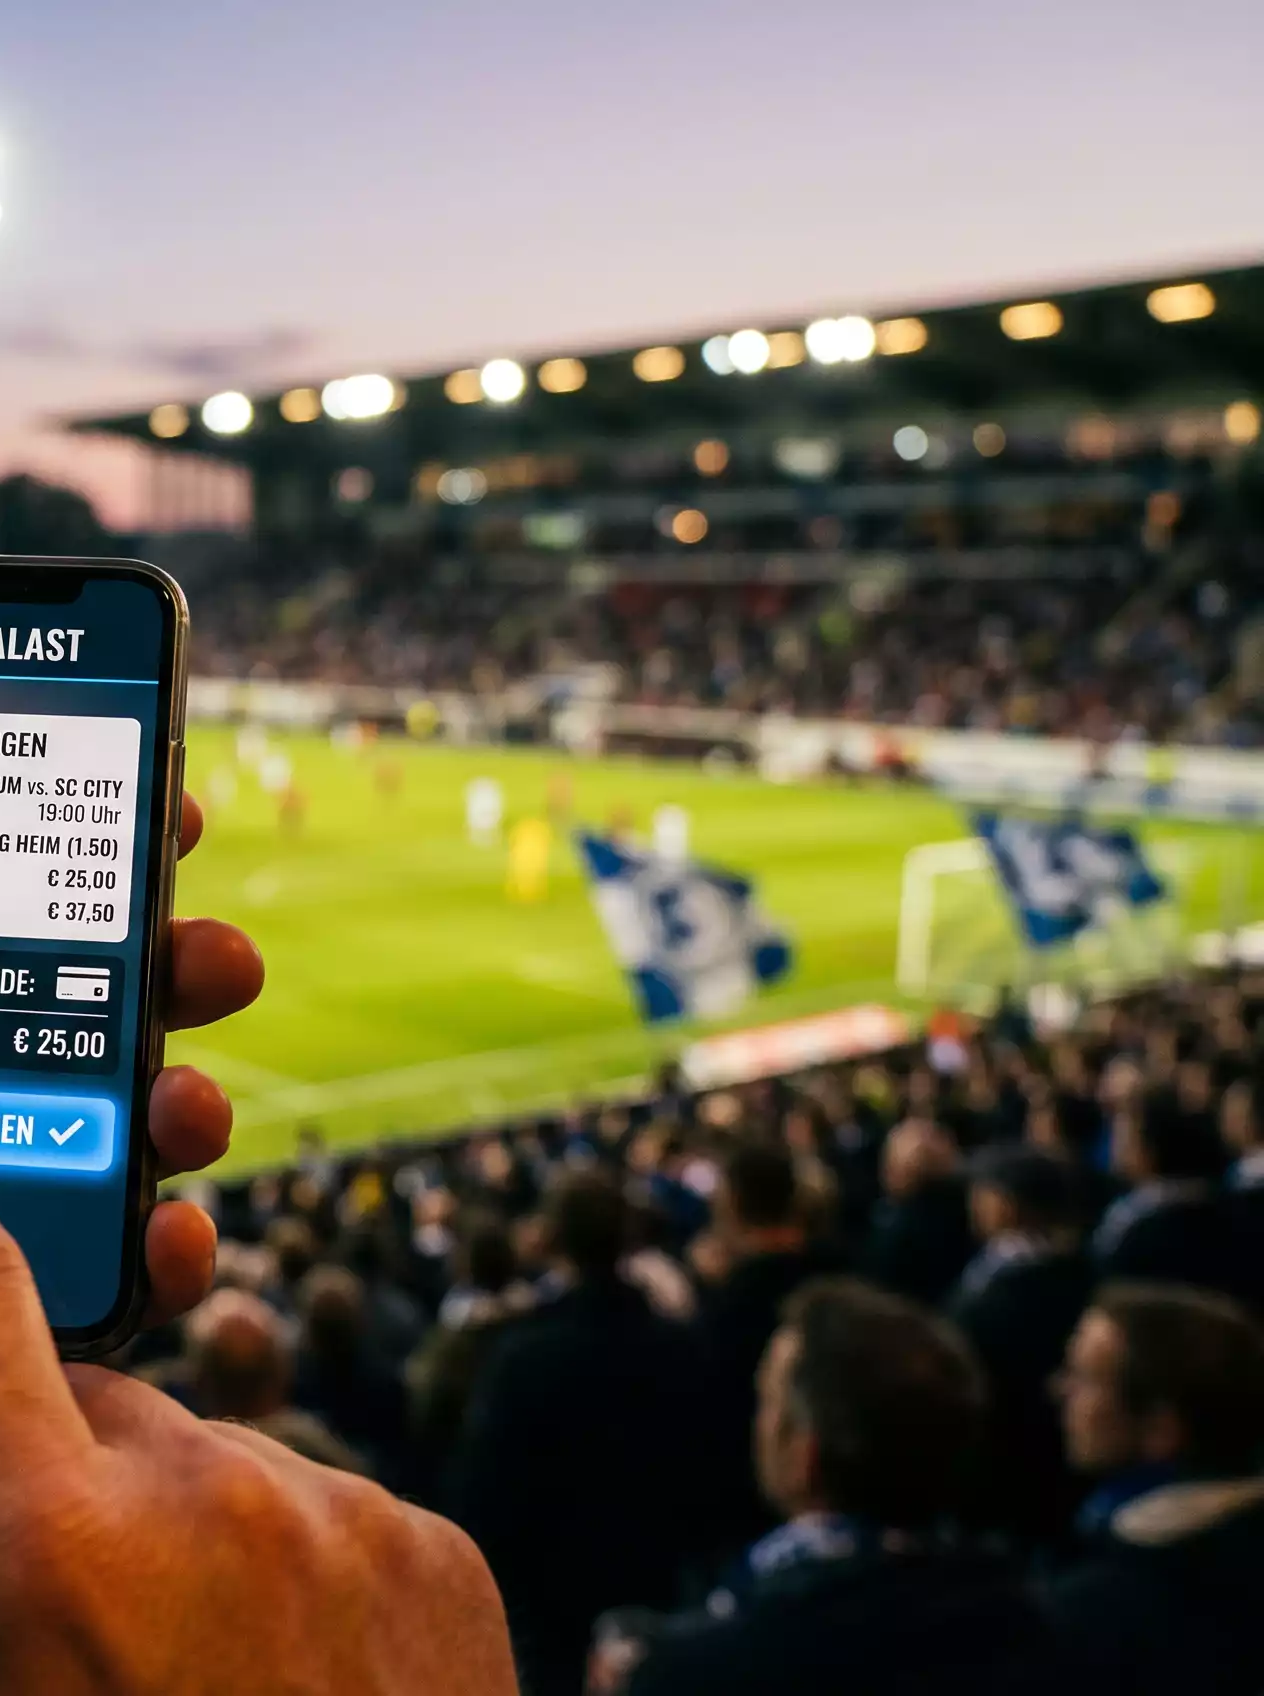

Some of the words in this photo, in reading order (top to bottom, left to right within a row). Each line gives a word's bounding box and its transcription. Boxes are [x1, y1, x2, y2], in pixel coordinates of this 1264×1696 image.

[27, 781, 49, 796] vs.
[54, 778, 78, 797] SC
[83, 779, 123, 799] CITY
[38, 803, 85, 823] 19:00
[91, 805, 122, 825] Uhr
[16, 834, 60, 855] HEIM
[67, 837, 118, 860] (1.50)
[47, 869, 59, 887] €
[64, 869, 116, 891] 25,00
[47, 902, 59, 920] €
[65, 902, 115, 924] 37,50
[13, 1028, 29, 1053] €
[36, 1029, 105, 1059] 25,00
